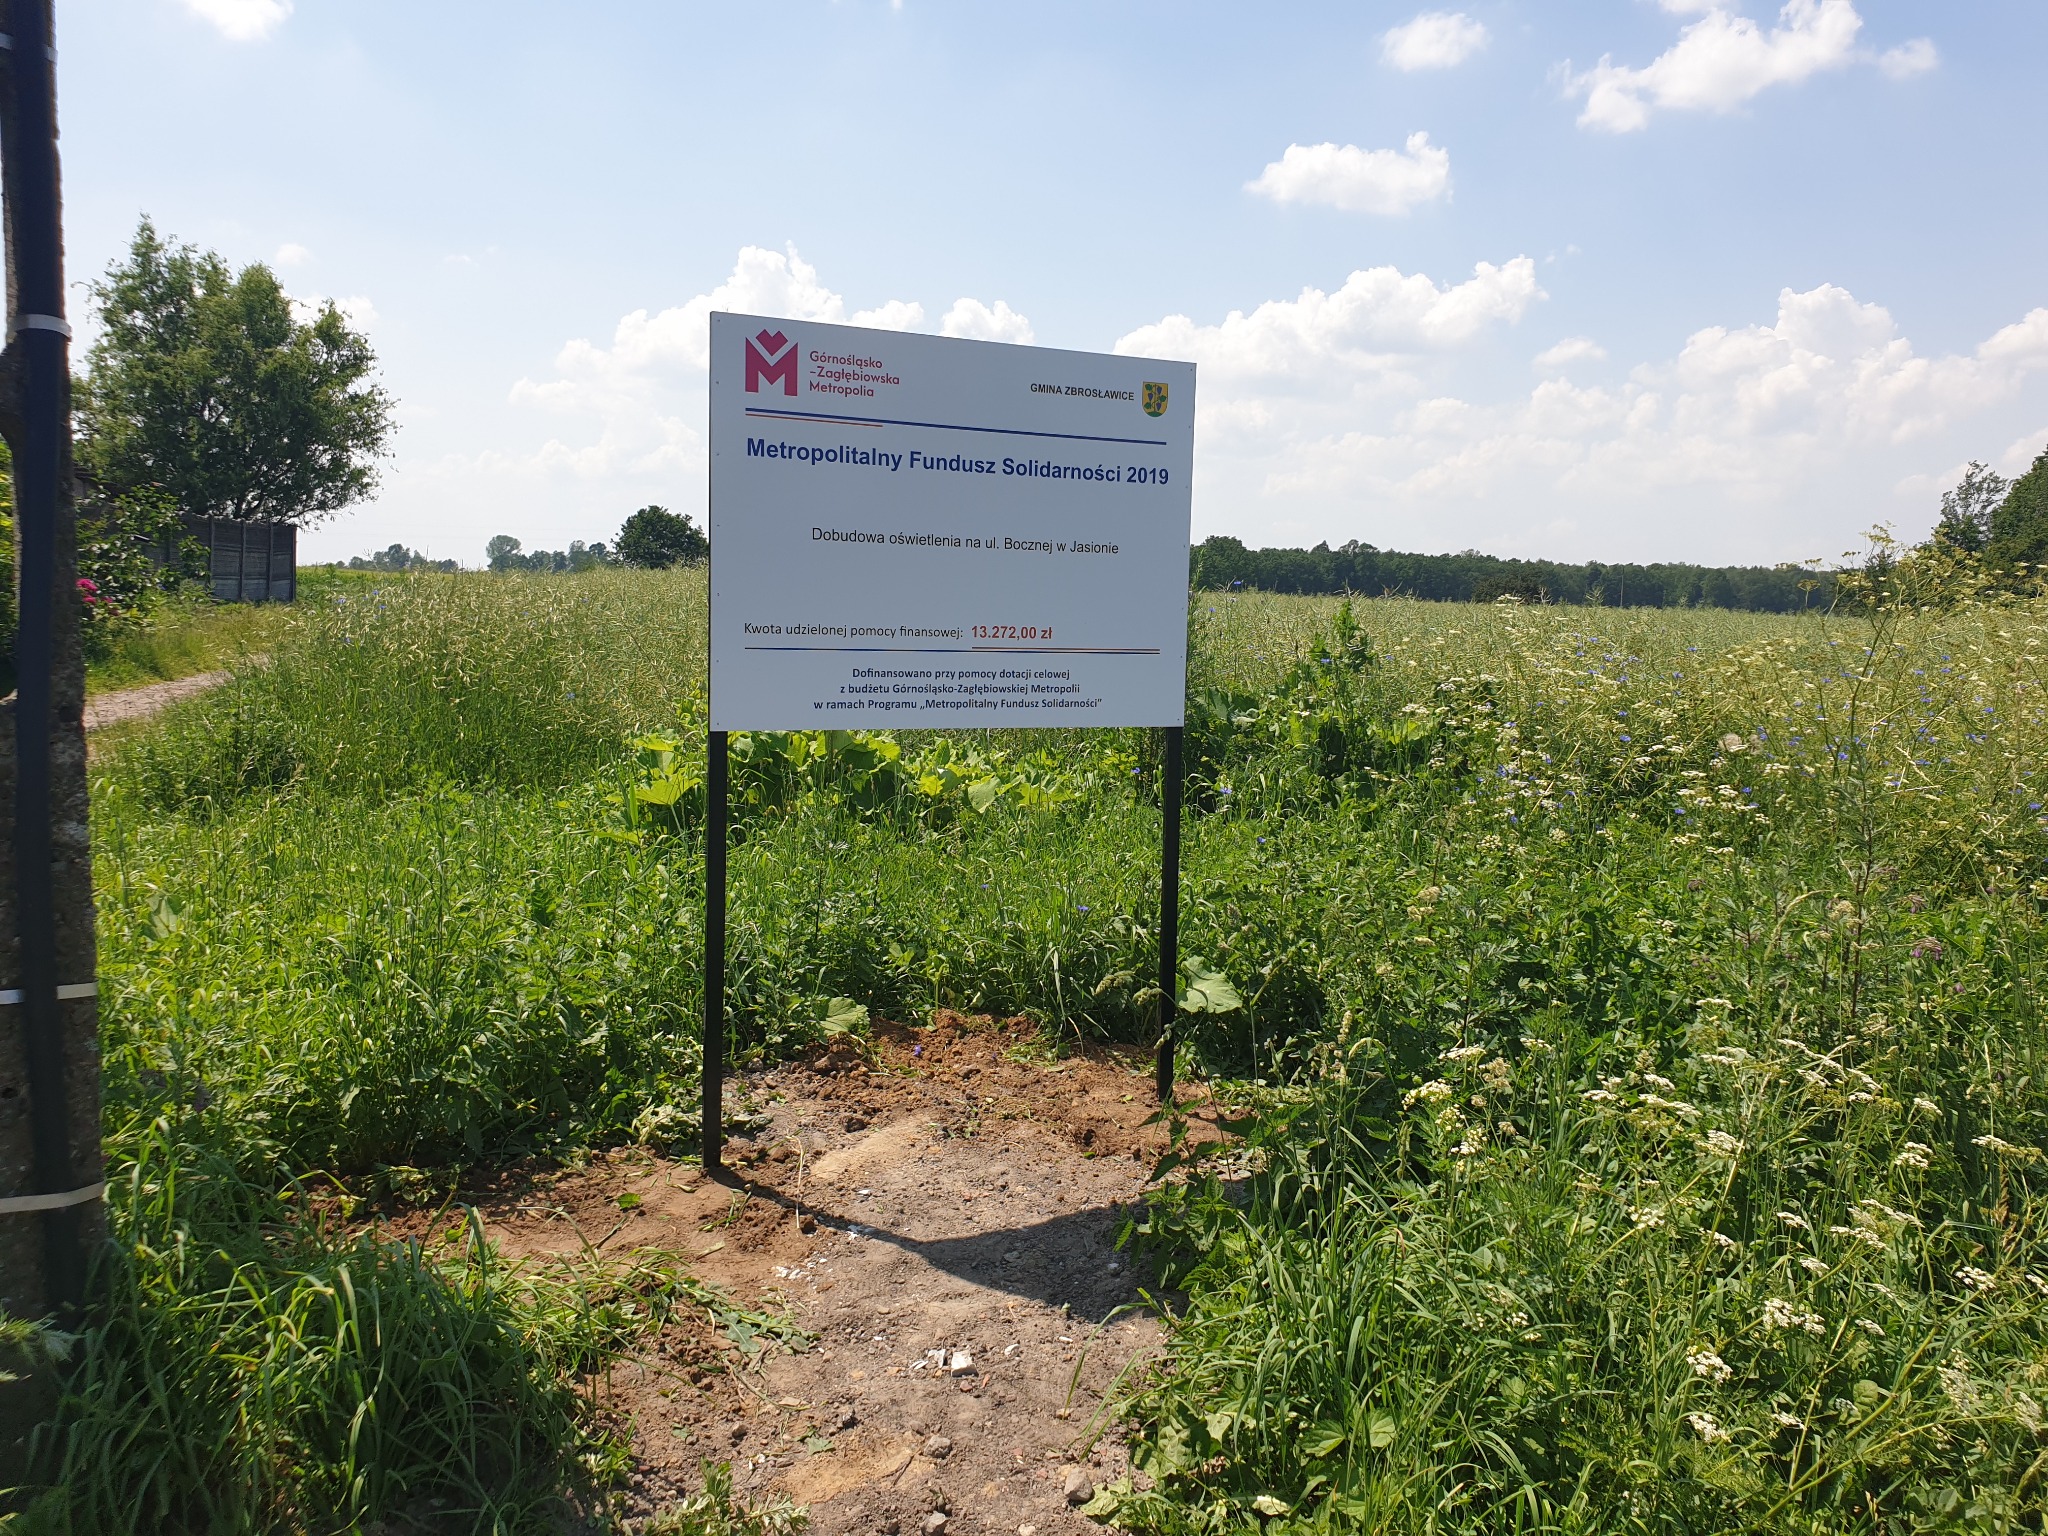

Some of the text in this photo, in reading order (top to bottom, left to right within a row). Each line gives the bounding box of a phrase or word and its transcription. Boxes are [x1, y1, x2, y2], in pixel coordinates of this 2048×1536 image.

[810, 350, 883, 370] Górnośląsko
[809, 380, 874, 398] Metropolia
[1030, 383, 1134, 401] GMINA ZBROSŁAWICE
[747, 437, 1169, 485] Metropolitalny Fundusz Solidarności 2019
[812, 527, 1119, 555] Dobudowa oświetlenia na ul. Bocznej w Jasionie
[744, 623, 1053, 641] Kwota udzielonej pomocy finansowej: 13.272,00 zł
[852, 668, 1070, 681] Dofinansowano przy pomocy dotacji celowej
[848, 683, 890, 694] budżetu
[892, 683, 1028, 695] Górnośląsko-Zagłębiowskiej
[1031, 684, 1080, 695] Metropolii
[826, 699, 865, 709] ramach
[868, 699, 917, 711] Programu
[1001, 699, 1039, 708] Fundusz
